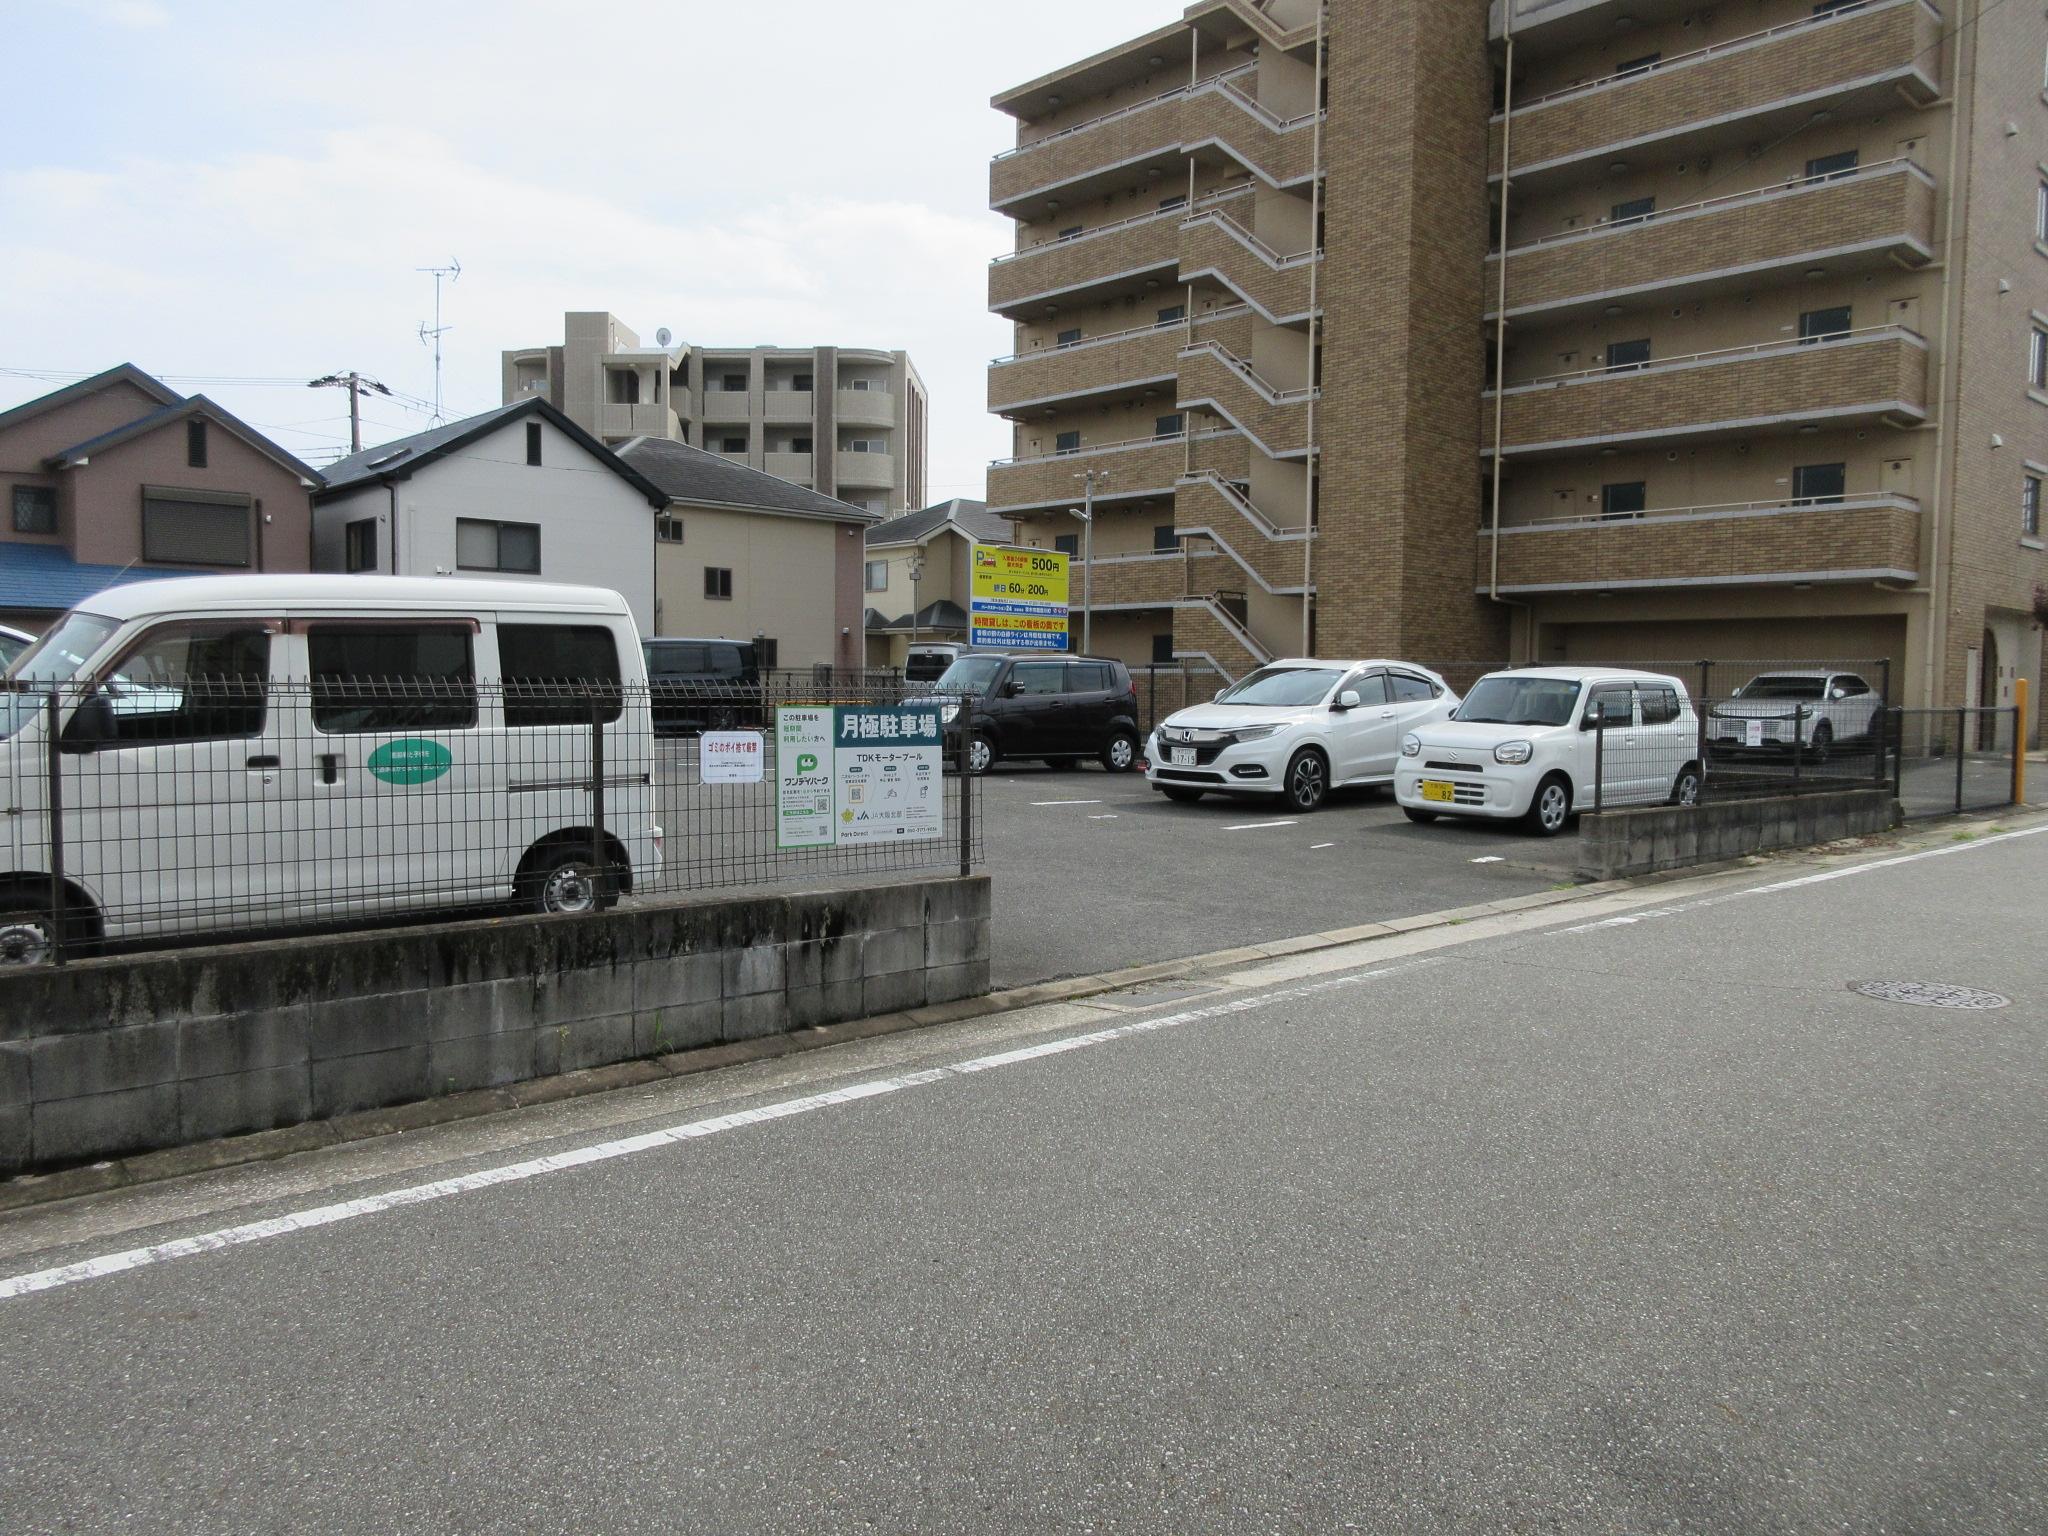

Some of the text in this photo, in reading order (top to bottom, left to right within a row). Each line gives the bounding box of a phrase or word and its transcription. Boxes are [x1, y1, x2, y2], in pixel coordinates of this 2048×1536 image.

[1032, 558, 1060, 572] 500円
[841, 713, 938, 739] 月極駐車場
[856, 752, 923, 762] TDKモータープール
[1441, 790, 1452, 801] 82
